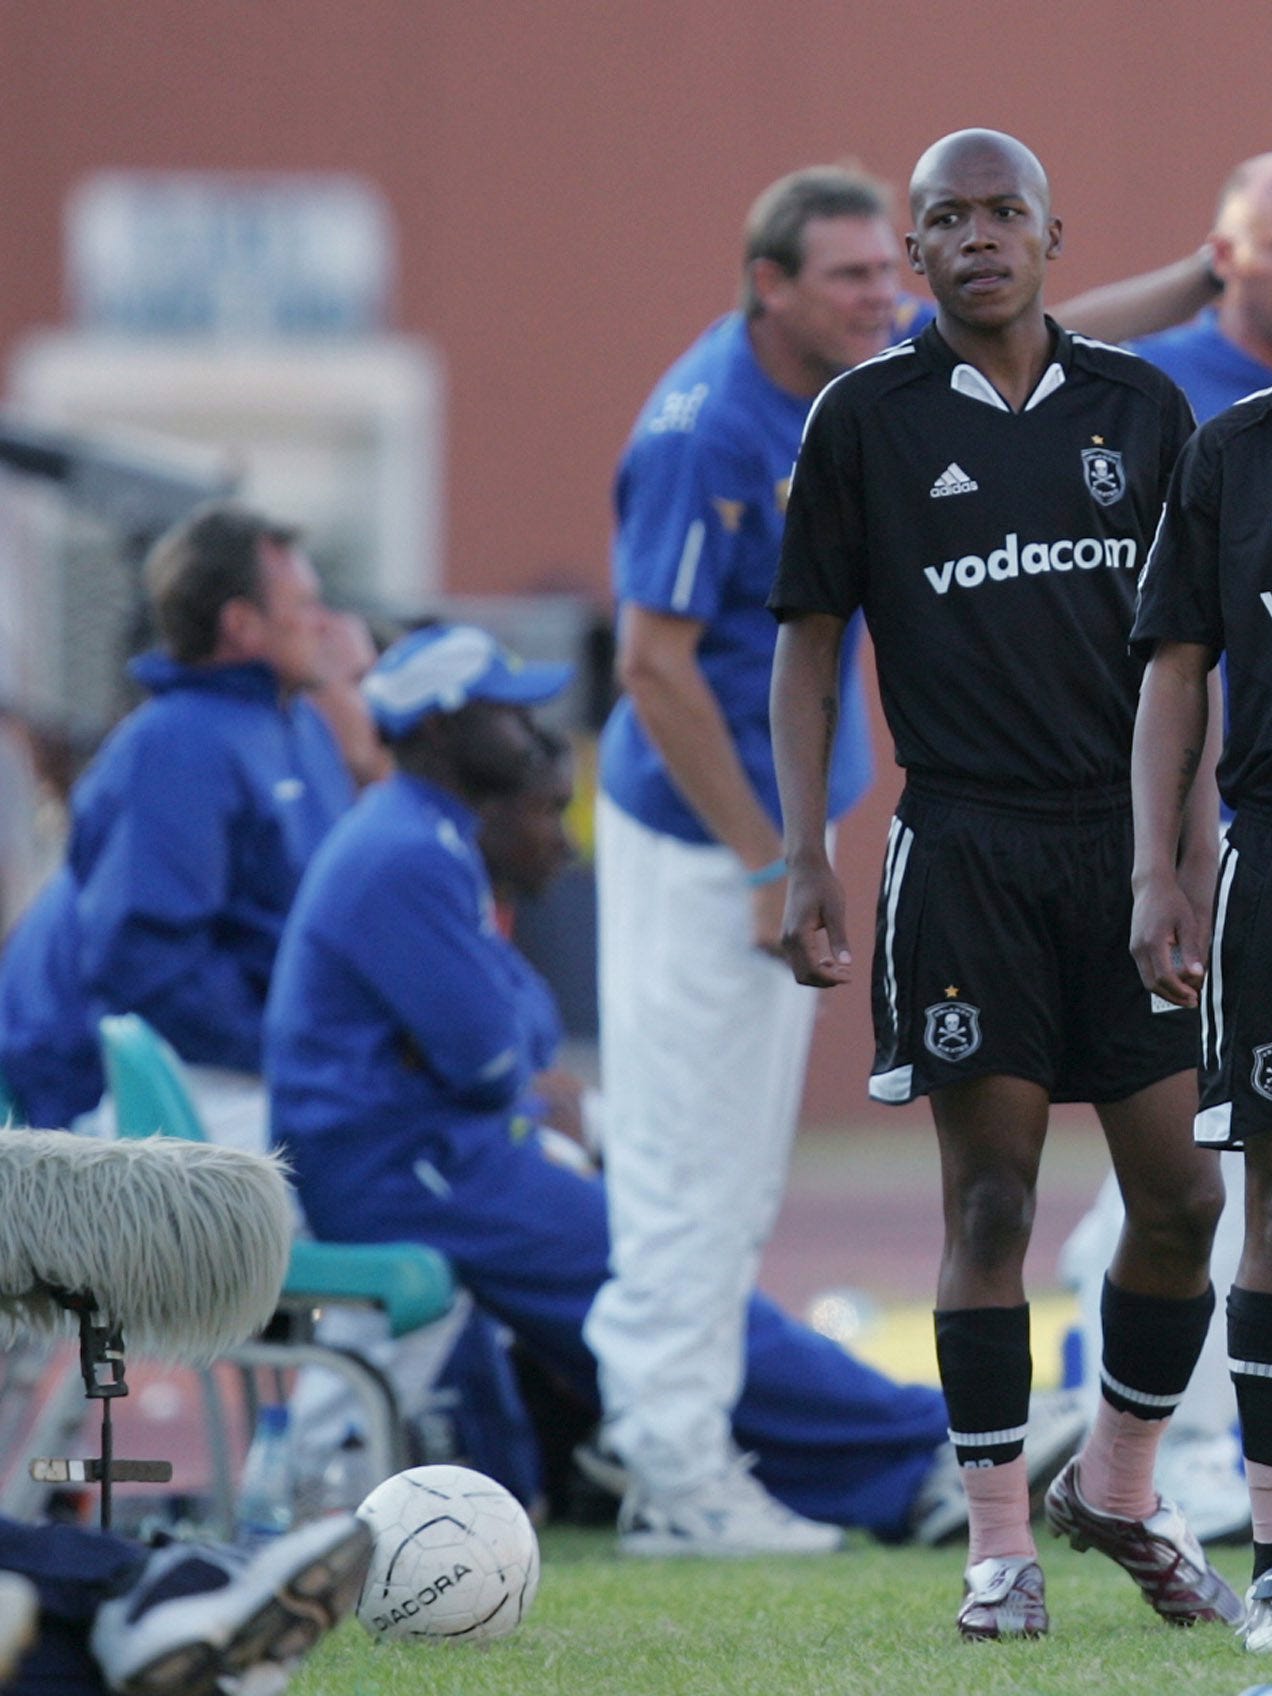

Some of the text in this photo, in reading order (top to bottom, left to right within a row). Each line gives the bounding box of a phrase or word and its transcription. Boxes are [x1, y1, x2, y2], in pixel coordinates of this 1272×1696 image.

[930, 479, 978, 498] adidas
[923, 533, 1137, 595] vodacom
[372, 1564, 472, 1632] DIADORA
